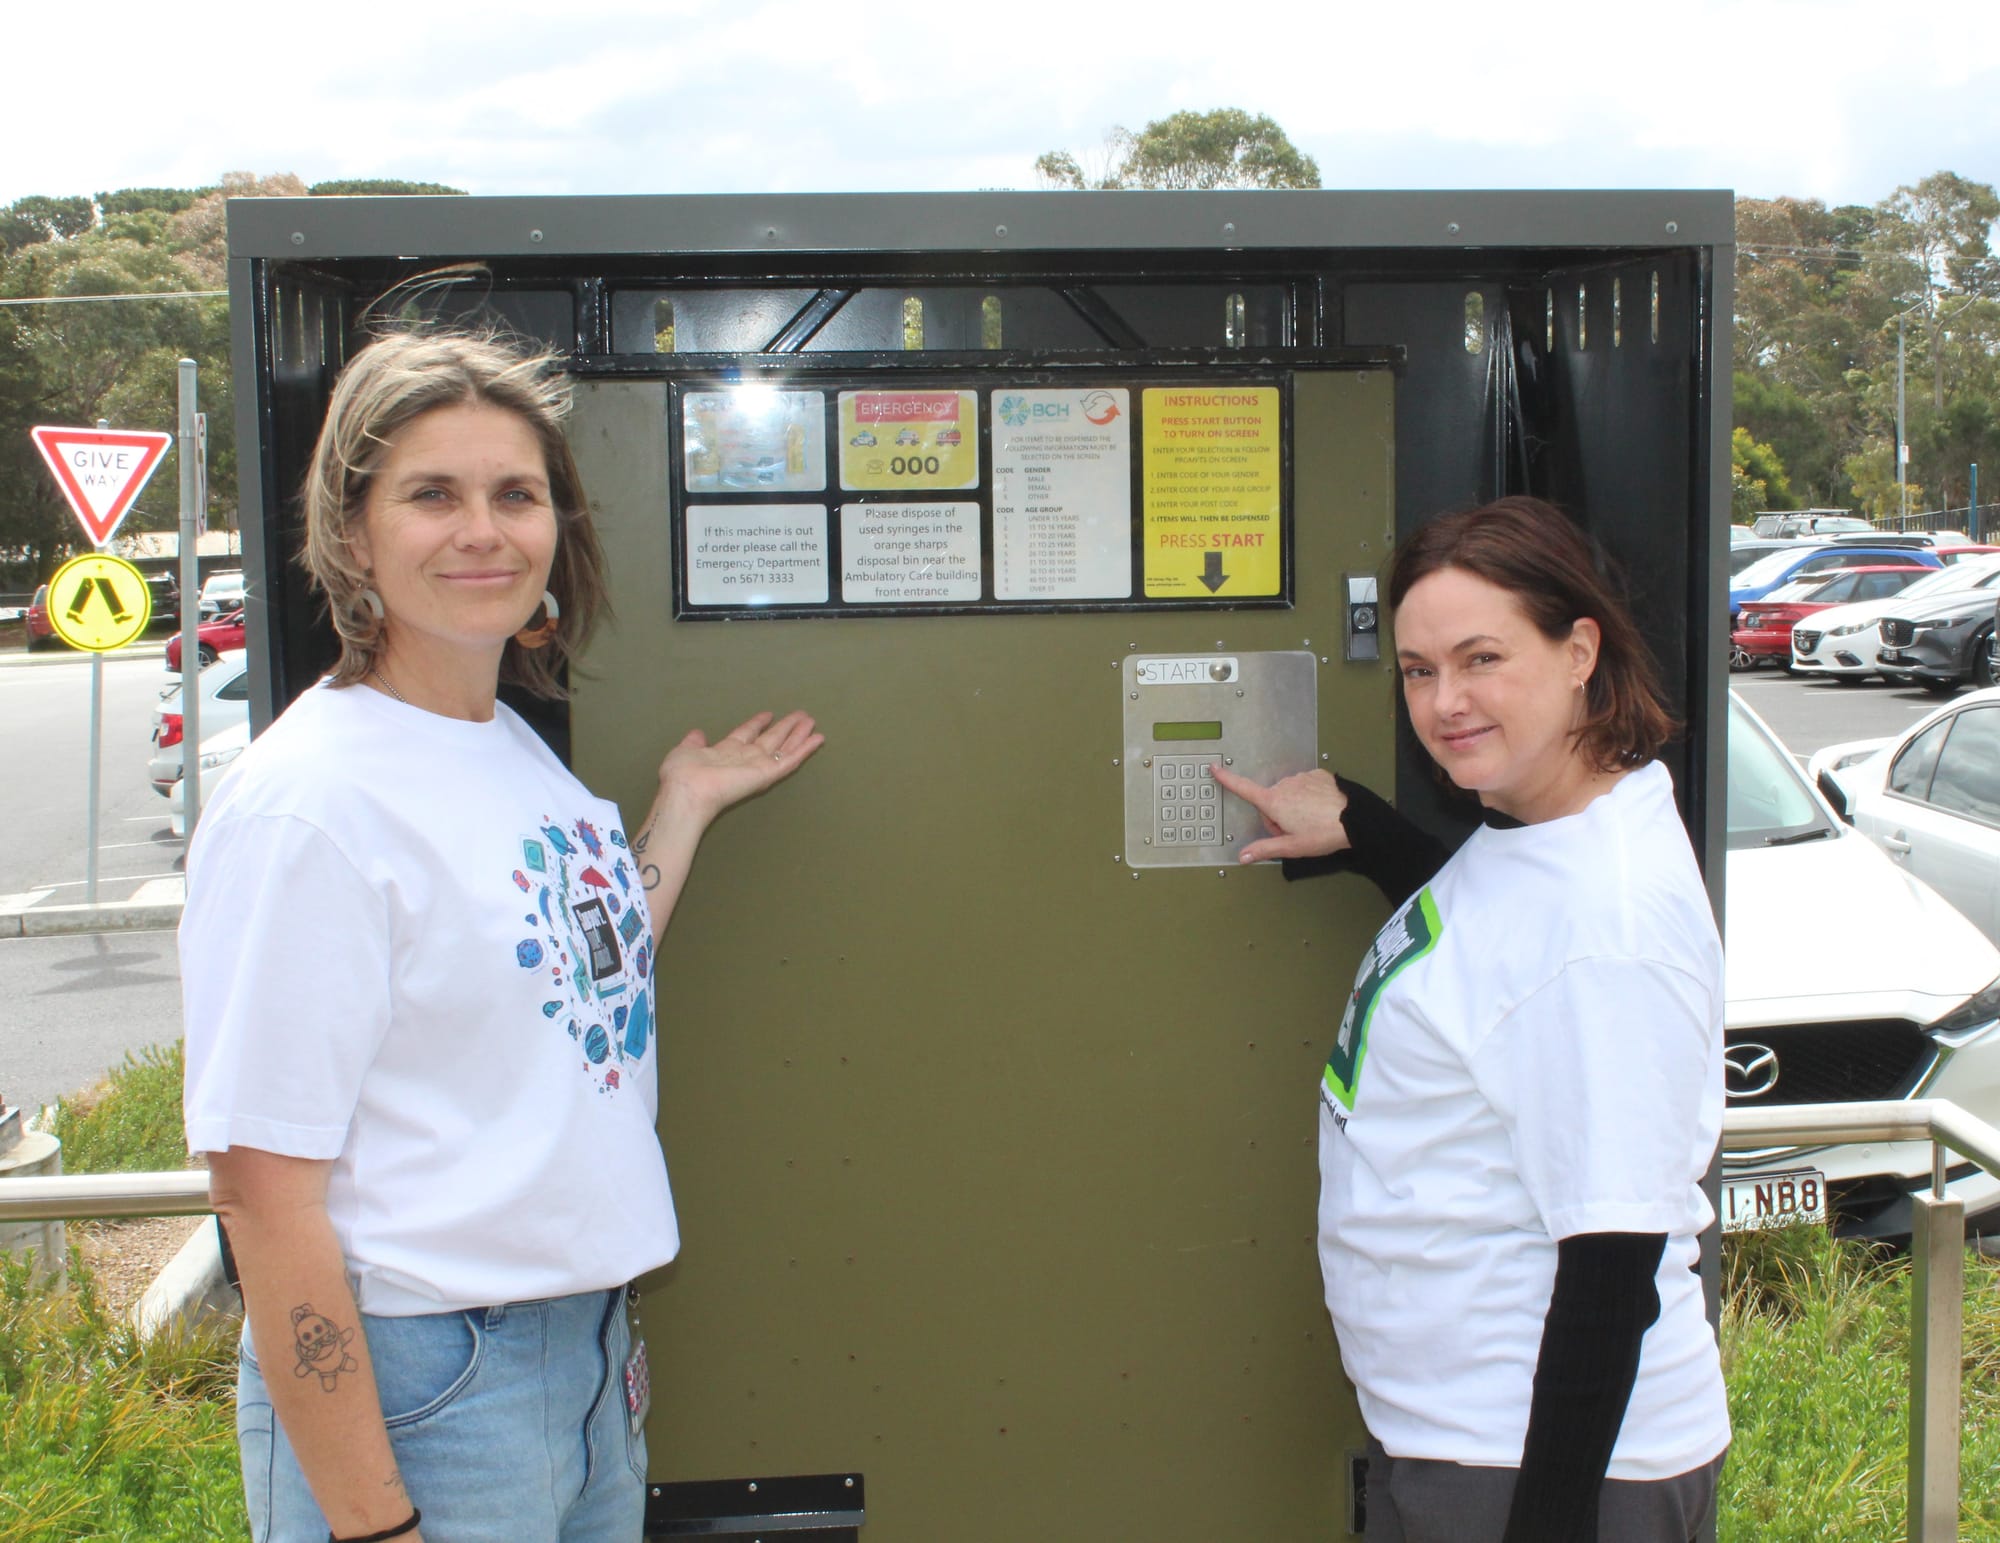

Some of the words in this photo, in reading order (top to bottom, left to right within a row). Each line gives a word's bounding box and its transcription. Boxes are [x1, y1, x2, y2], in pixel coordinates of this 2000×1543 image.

[861, 400, 953, 415] EMERGENCY
[1164, 395, 1259, 407] INSTRUCTIONS
[1032, 404, 1069, 416] BCH
[1162, 417, 1188, 425] PRESS
[1192, 417, 1220, 425] START
[1224, 416, 1261, 425] BUTTON
[1164, 430, 1176, 438] TO
[1180, 430, 1204, 438] TURN
[1225, 429, 1259, 437] SCREEN
[74, 451, 129, 470] GIVE
[890, 456, 939, 475] 000
[84, 474, 121, 488] WAY
[865, 509, 899, 518] Please
[902, 508, 941, 521] dispose
[945, 508, 955, 518] of
[704, 527, 712, 537] If
[714, 526, 734, 537] this
[737, 526, 781, 536] machine
[785, 526, 793, 536] is
[795, 527, 813, 536] out
[859, 524, 883, 534] used
[886, 524, 930, 537] syringes
[933, 524, 943, 533] in
[945, 524, 962, 533] the
[874, 541, 911, 552] orange
[914, 539, 948, 551] sharps
[1160, 534, 1207, 548] PRESS
[1211, 533, 1264, 547] START
[698, 543, 708, 553] of
[711, 542, 740, 553] order
[743, 542, 778, 555] please
[780, 541, 797, 551] call
[801, 541, 818, 551] the
[696, 559, 753, 571] Emergency
[757, 557, 820, 570] Department
[857, 556, 900, 568] disposal
[903, 555, 919, 565] bin
[949, 555, 965, 565] the
[723, 575, 736, 584] on
[739, 573, 764, 584] 5671
[769, 573, 794, 583] 3333
[845, 572, 905, 584] Ambulatory
[909, 571, 933, 581] Care
[936, 570, 978, 582] building
[875, 587, 901, 597] front
[904, 587, 948, 597] entrance
[1146, 662, 1209, 681] START
[1185, 768, 1191, 776] 2
[1166, 789, 1171, 797] 4
[1186, 788, 1191, 797] 5
[1205, 788, 1210, 796] 6
[1167, 809, 1172, 818] 7
[1186, 809, 1191, 817] 8
[1205, 809, 1210, 817] 9
[1186, 830, 1191, 838] 0
